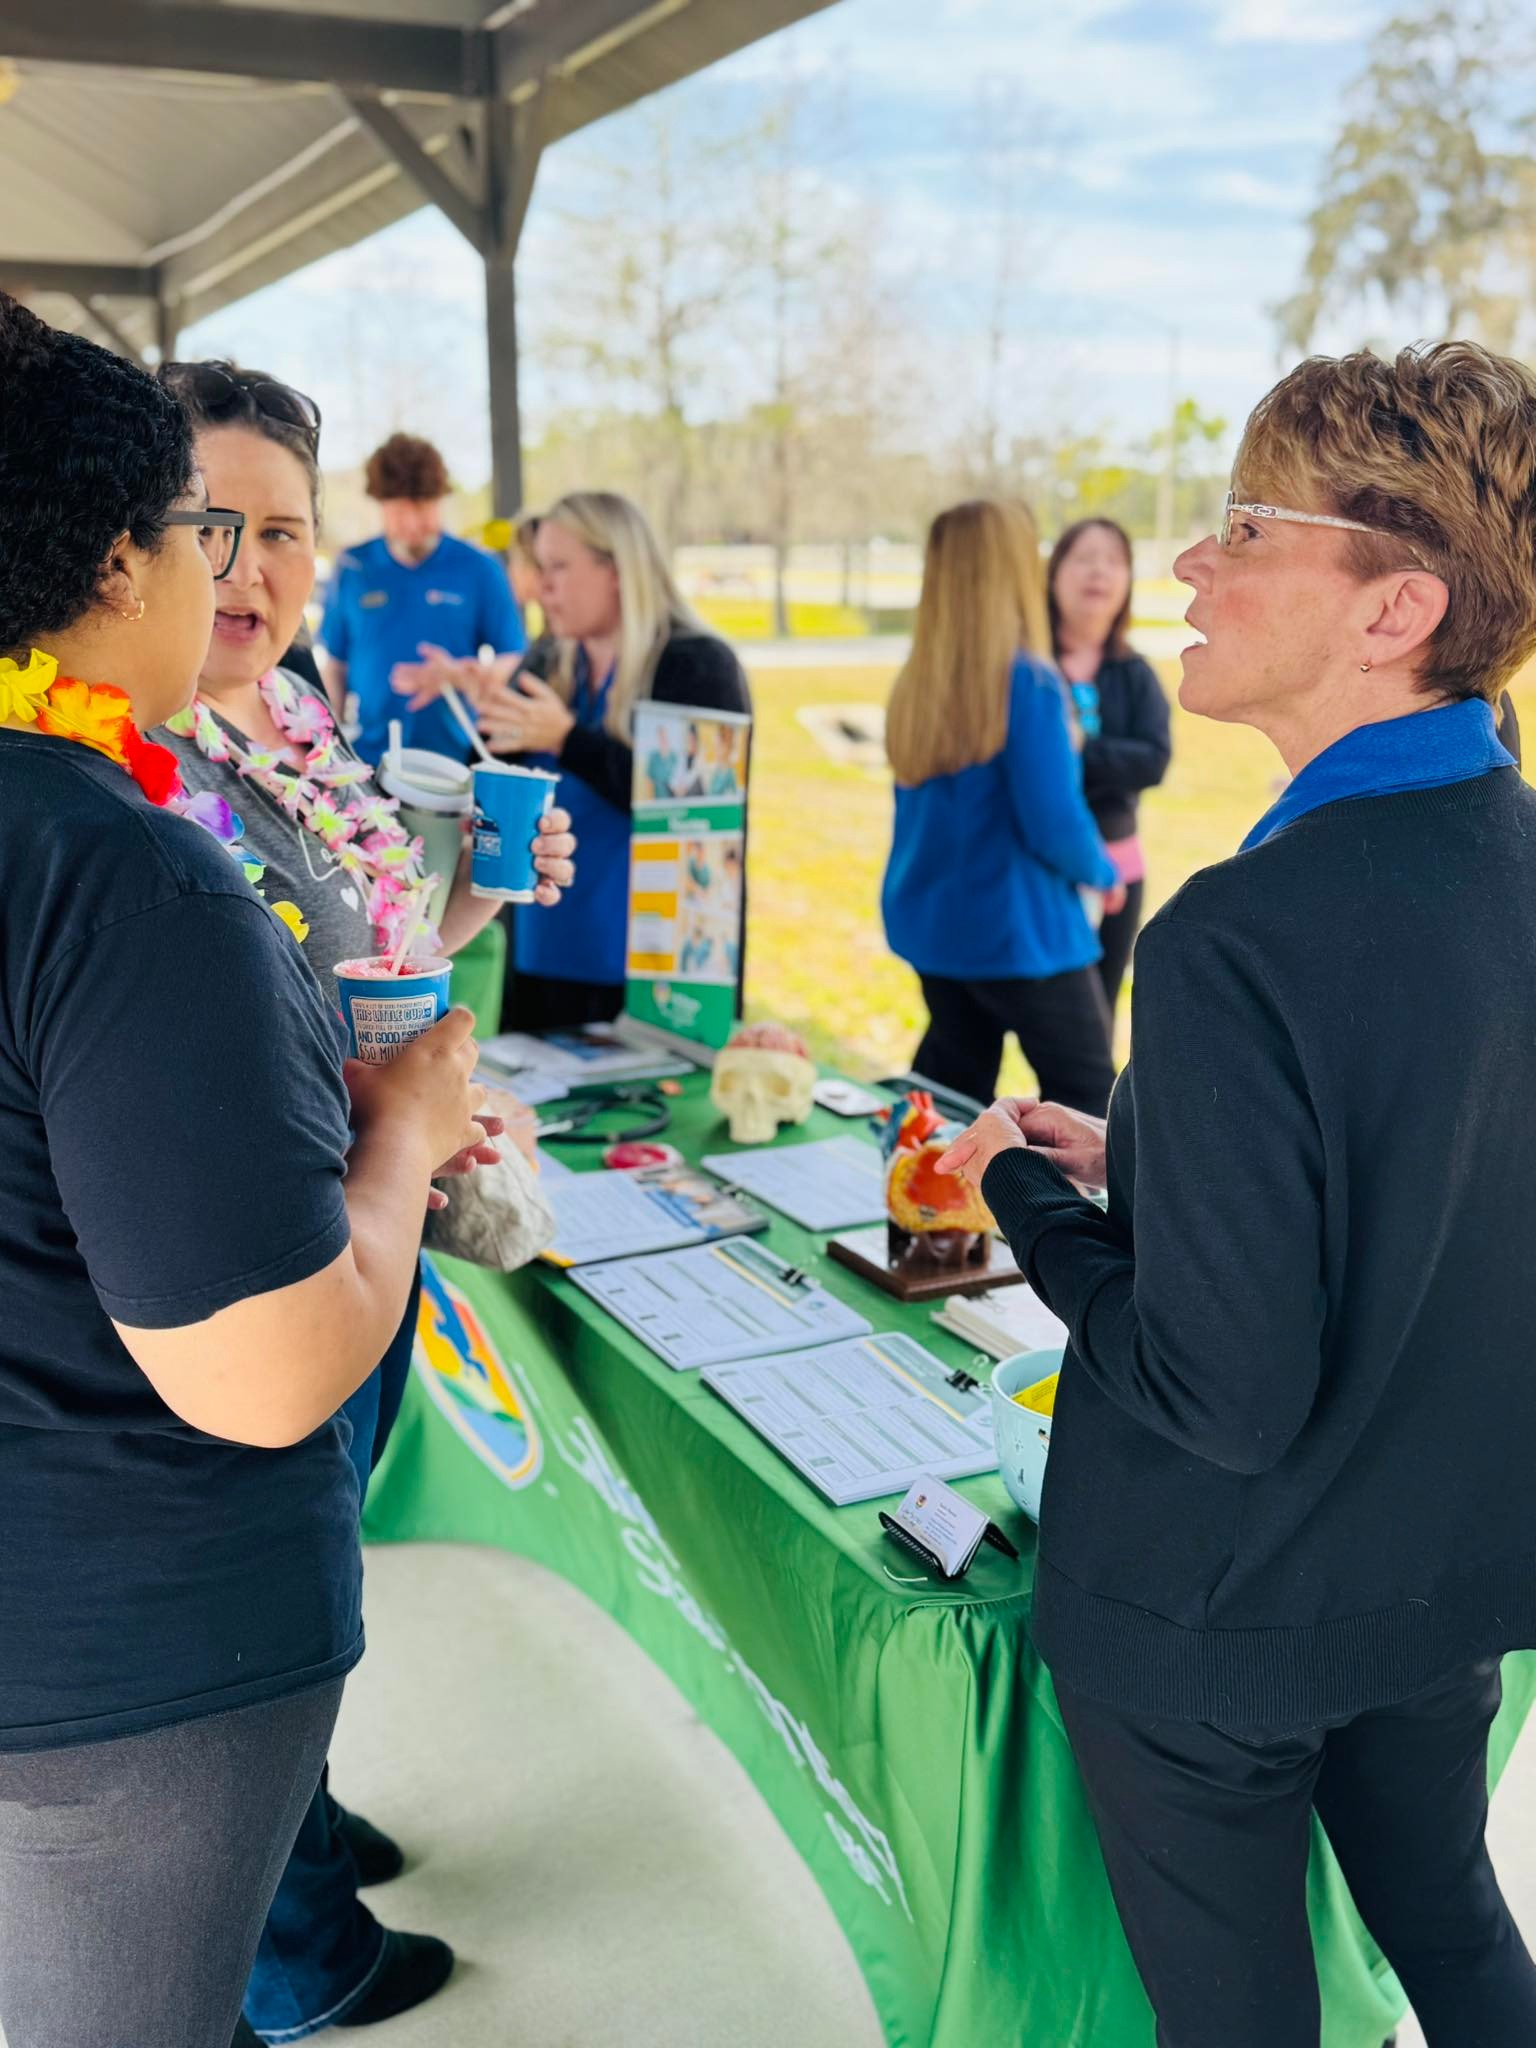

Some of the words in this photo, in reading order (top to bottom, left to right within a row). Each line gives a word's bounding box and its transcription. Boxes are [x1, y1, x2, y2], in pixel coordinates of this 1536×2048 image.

[354, 1008, 372, 1021] THIS
[373, 1009, 403, 1021] LITTLE
[358, 1030, 373, 1043] AND
[375, 1031, 400, 1044] GOOD
[402, 1029, 418, 1037] FOR
